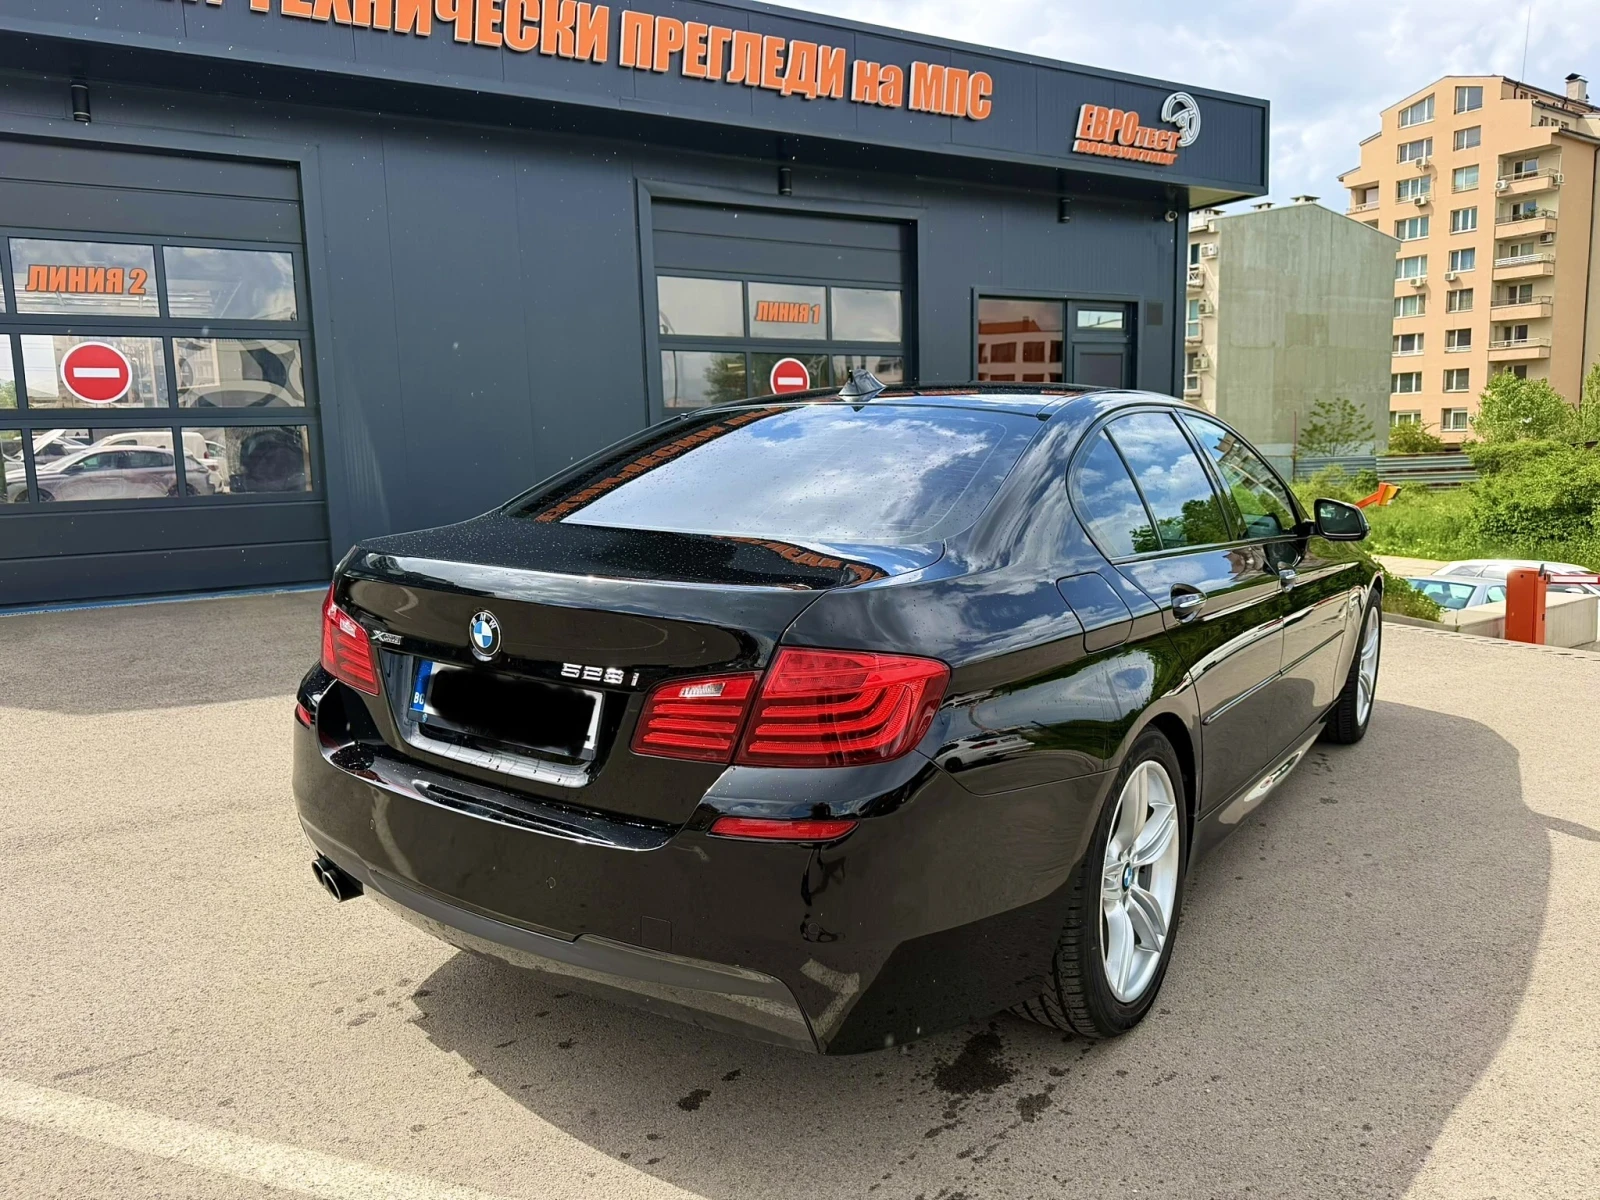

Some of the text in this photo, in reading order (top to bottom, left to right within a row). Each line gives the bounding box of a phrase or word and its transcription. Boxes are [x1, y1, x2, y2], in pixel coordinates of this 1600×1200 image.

[250, 0, 992, 120] ИЧЕСКИ ПРЕГЛЕДИ на МПС
[25, 264, 148, 295] ЛИНИЯ 2
[755, 300, 821, 324] ЛИНИЯ 1
[470, 612, 498, 630] BMW
